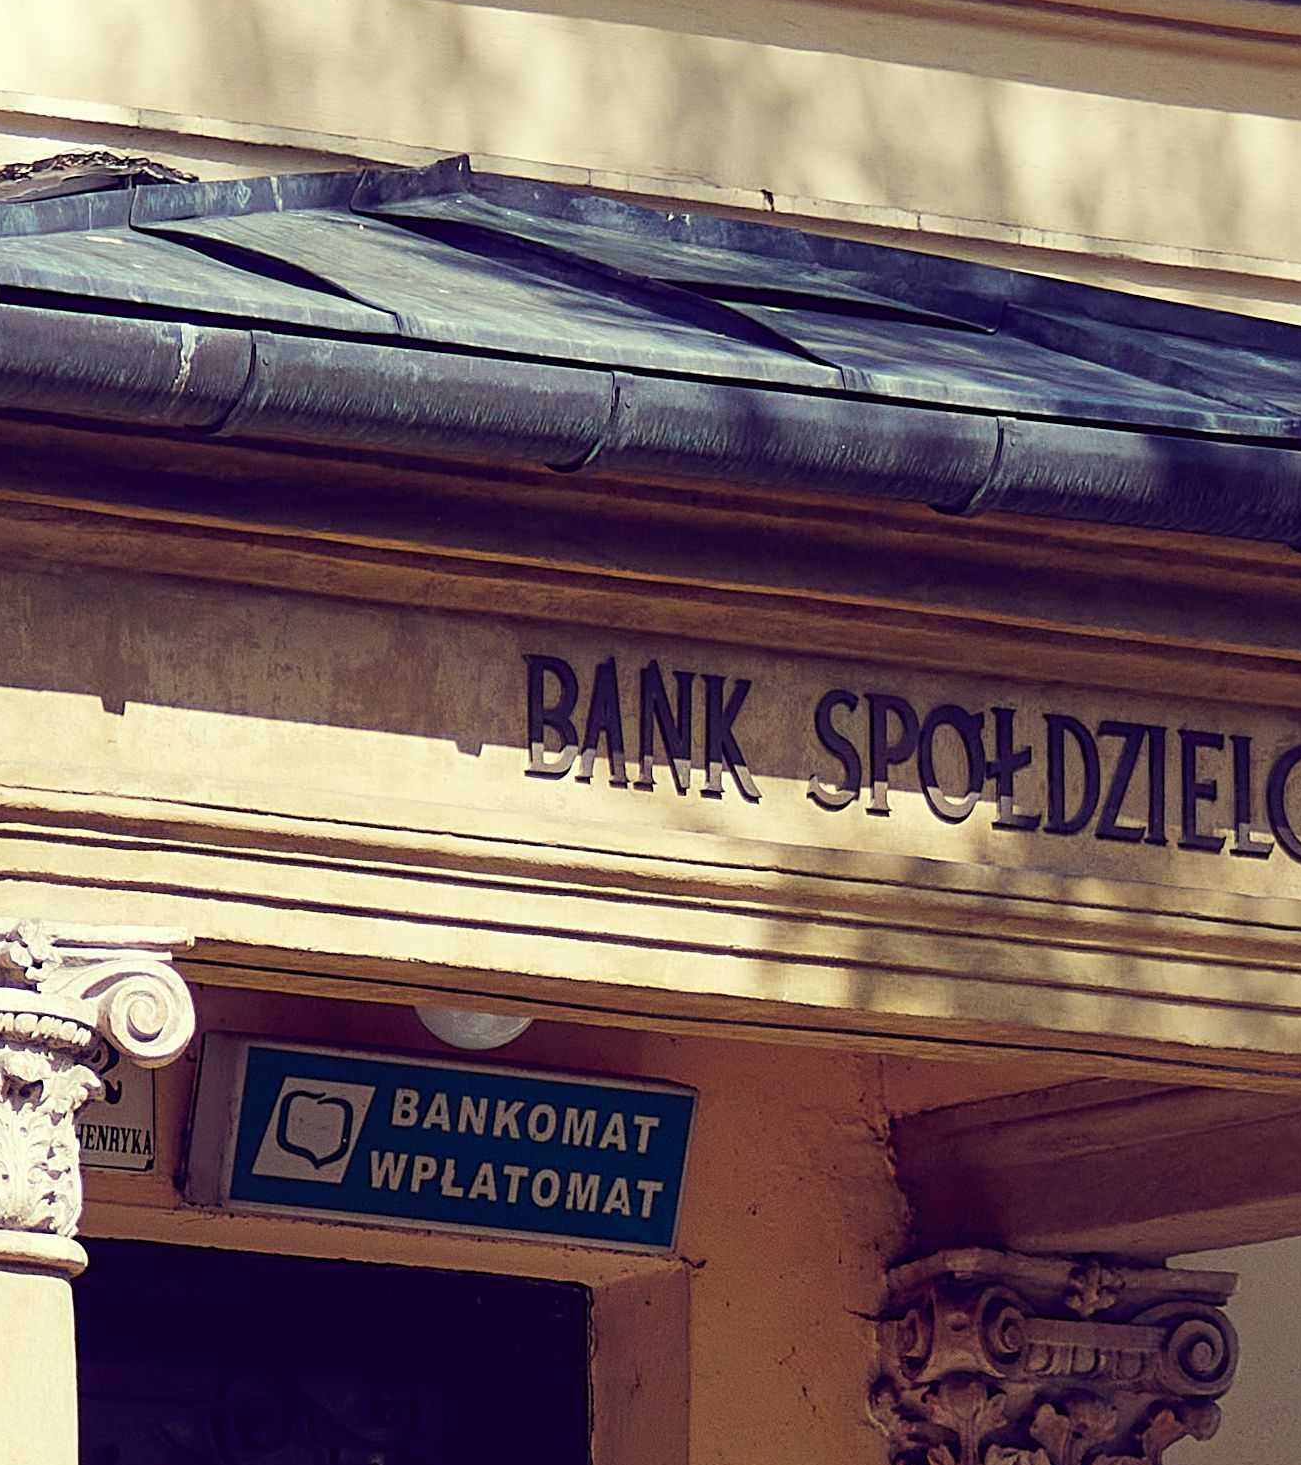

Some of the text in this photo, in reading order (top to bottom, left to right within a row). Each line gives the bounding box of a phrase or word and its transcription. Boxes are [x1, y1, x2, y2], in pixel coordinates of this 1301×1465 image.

[525, 654, 761, 803] BANK
[391, 1087, 660, 1154] BANKOMAT
[370, 1150, 663, 1219] WPŁATOMAT
